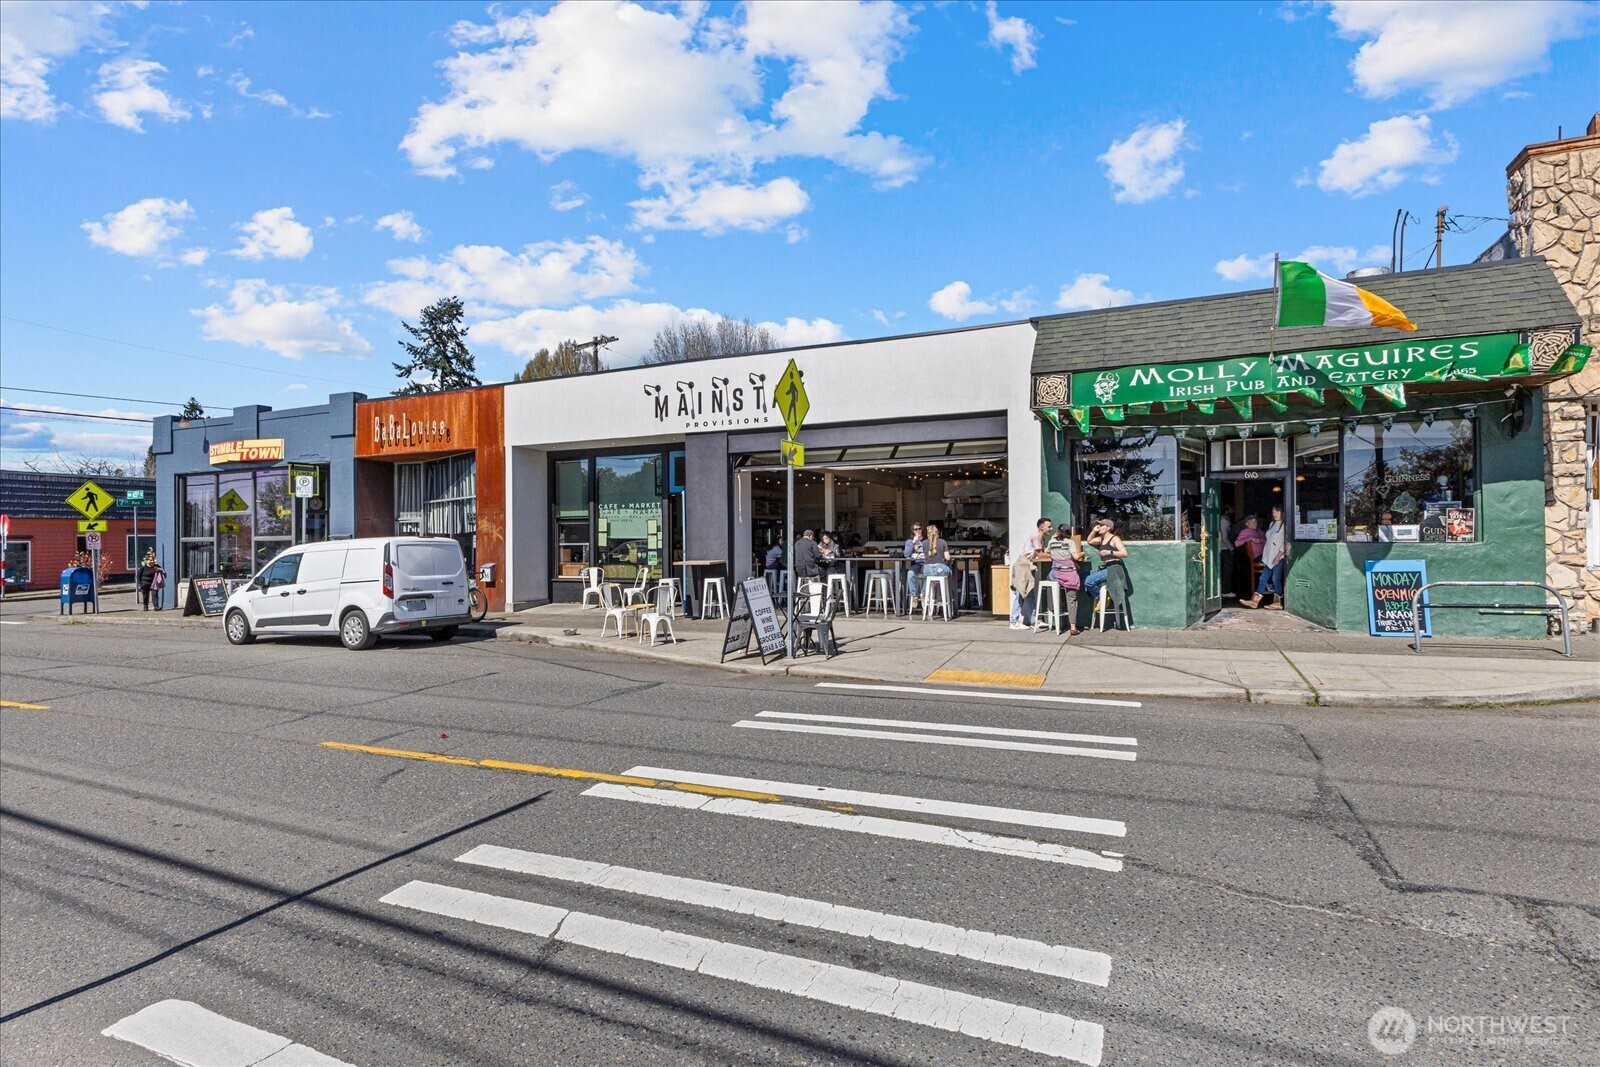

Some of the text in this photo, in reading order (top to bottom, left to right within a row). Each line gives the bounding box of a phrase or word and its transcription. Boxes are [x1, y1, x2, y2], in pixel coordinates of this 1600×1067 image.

[1129, 342, 1479, 386] MOLLY MAGUIRES
[1169, 384, 1214, 398] IRISH
[1226, 379, 1265, 392] PUB
[1277, 375, 1316, 388] AND
[1328, 368, 1412, 383] EATERY
[655, 383, 804, 418] MAINST
[686, 416, 769, 428] PROVISIONS
[210, 440, 243, 456] STUMBLE
[241, 447, 280, 460] TOWN
[1244, 471, 1259, 479] 610
[1384, 473, 1430, 483] GUINNESS
[1099, 483, 1134, 492] GUINNESS
[1423, 526, 1446, 535] GUIN
[1372, 572, 1419, 590] MONDAY
[755, 606, 772, 617] COFFEE
[761, 616, 773, 624] WINE
[763, 624, 775, 634] BEER
[760, 631, 784, 645] GROCERIES
[762, 643, 774, 653] GRAB
